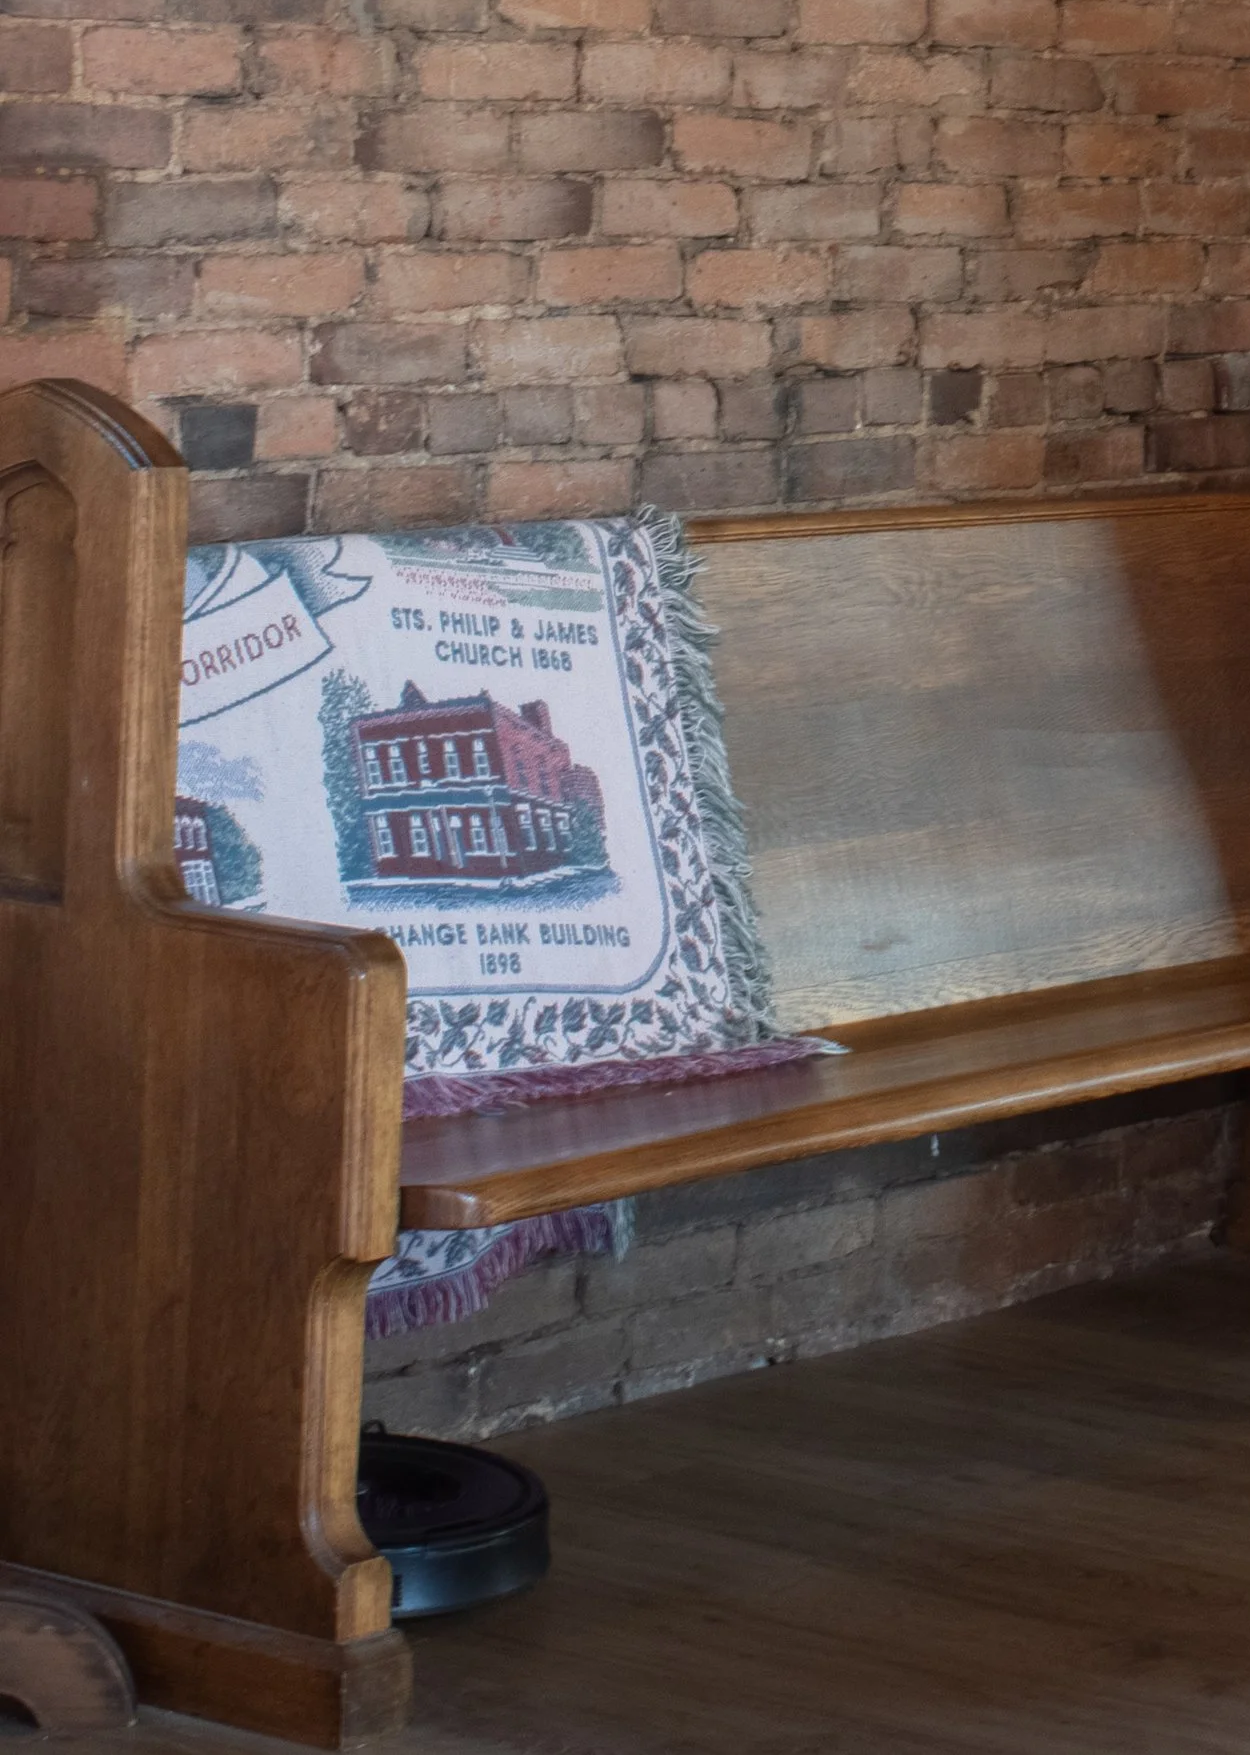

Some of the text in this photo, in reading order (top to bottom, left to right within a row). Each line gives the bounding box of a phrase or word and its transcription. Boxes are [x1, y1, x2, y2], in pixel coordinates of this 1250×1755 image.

[391, 607, 599, 645] STS. PHILIP & JAMES
[434, 640, 573, 671] CHURCH 1868
[378, 923, 631, 947] HANGE BANK BUILDING
[480, 951, 523, 975] 1898
